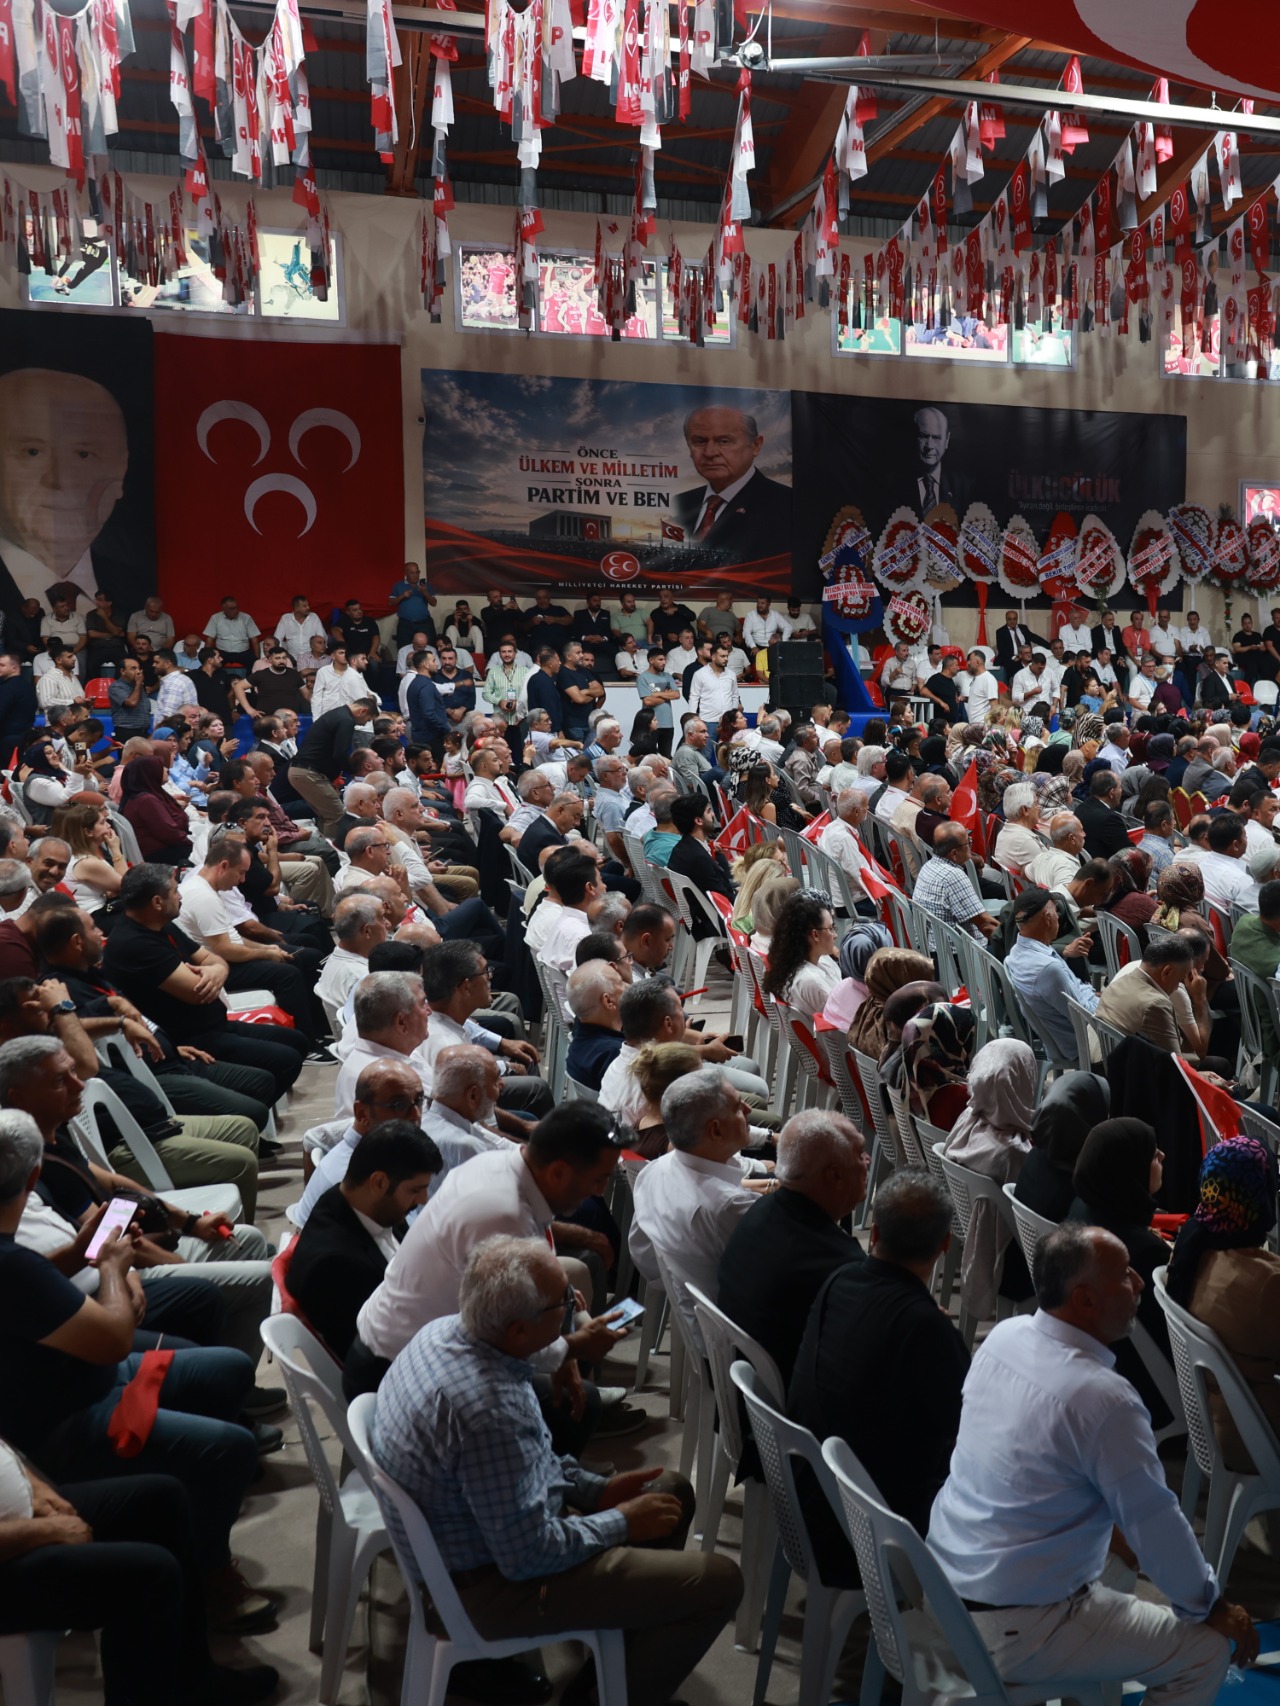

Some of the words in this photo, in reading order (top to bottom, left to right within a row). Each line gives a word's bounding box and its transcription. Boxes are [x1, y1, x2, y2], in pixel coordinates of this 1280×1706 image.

[577, 445, 618, 459] ÖNCE
[519, 455, 575, 474] ÜLKEM
[579, 462, 598, 476] VE
[602, 460, 679, 479] MİLLETİM
[575, 477, 622, 488] SONRA
[527, 486, 601, 505] PARTİM
[606, 491, 628, 506] VE
[633, 491, 671, 508] BEN
